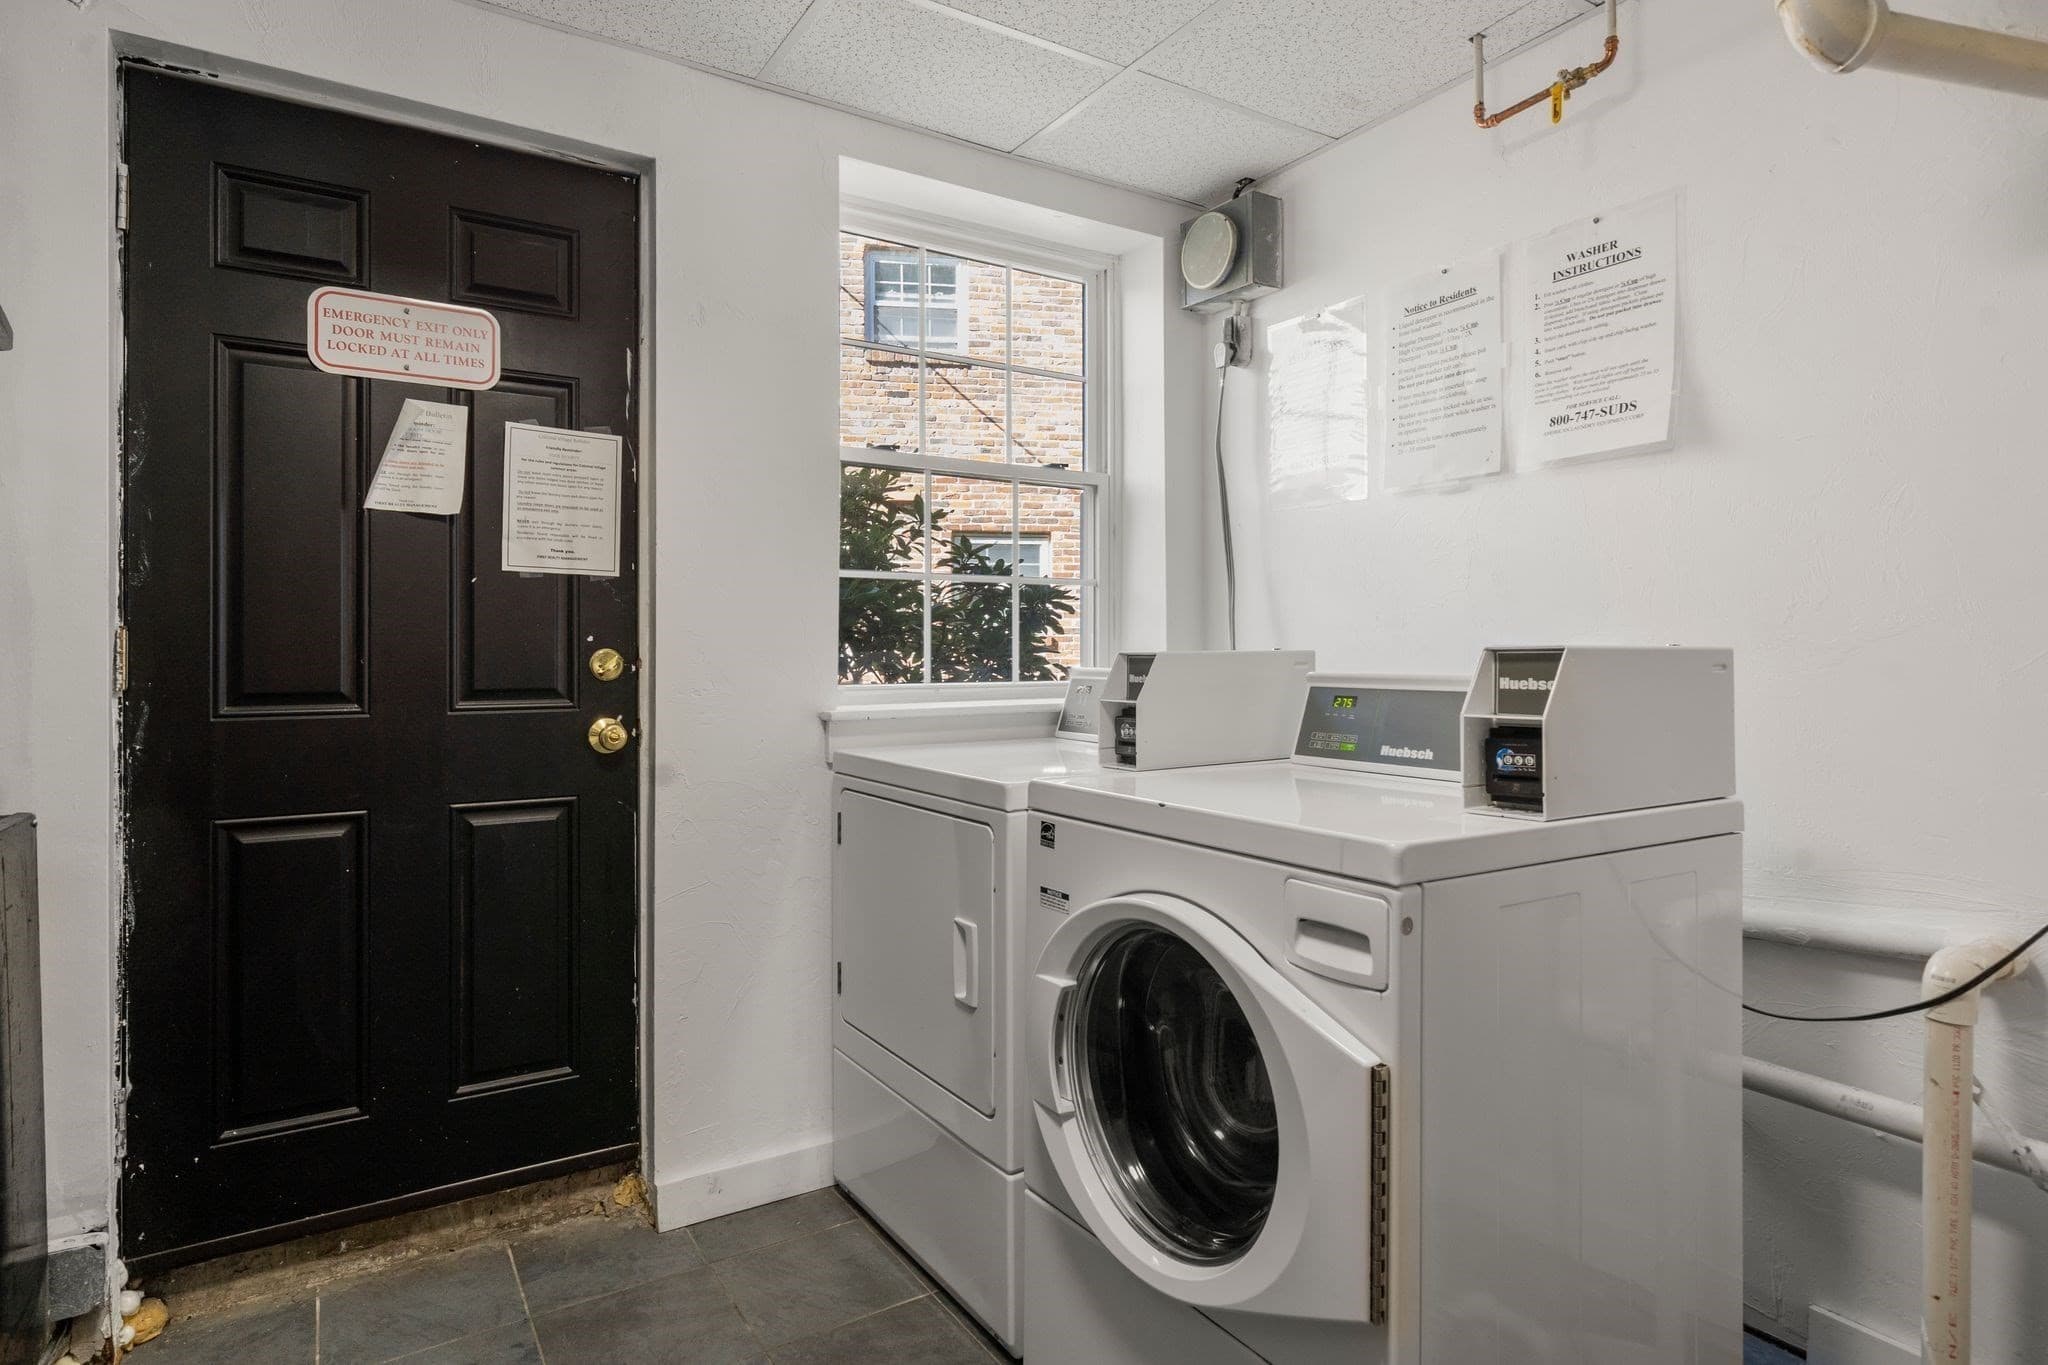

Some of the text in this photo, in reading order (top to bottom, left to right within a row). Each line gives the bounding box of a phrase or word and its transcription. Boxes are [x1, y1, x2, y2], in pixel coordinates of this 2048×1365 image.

[1552, 246, 1642, 281] INSTRUCTIONS
[1566, 240, 1618, 262] WASHER
[1404, 287, 1477, 315] Notice to Residents
[323, 307, 488, 340] EMERGENCY EXIT ONLY
[332, 324, 480, 353] DOOR MUST REMAIN
[327, 339, 485, 369] LOCKED AT ALL TIMES
[1549, 400, 1637, 427] 800-747-SUDS
[1566, 402, 1578, 410] FOR
[1579, 397, 1603, 407] SERVICE
[1500, 677, 1556, 691] Huebsc
[1380, 745, 1434, 761] Huebsch
